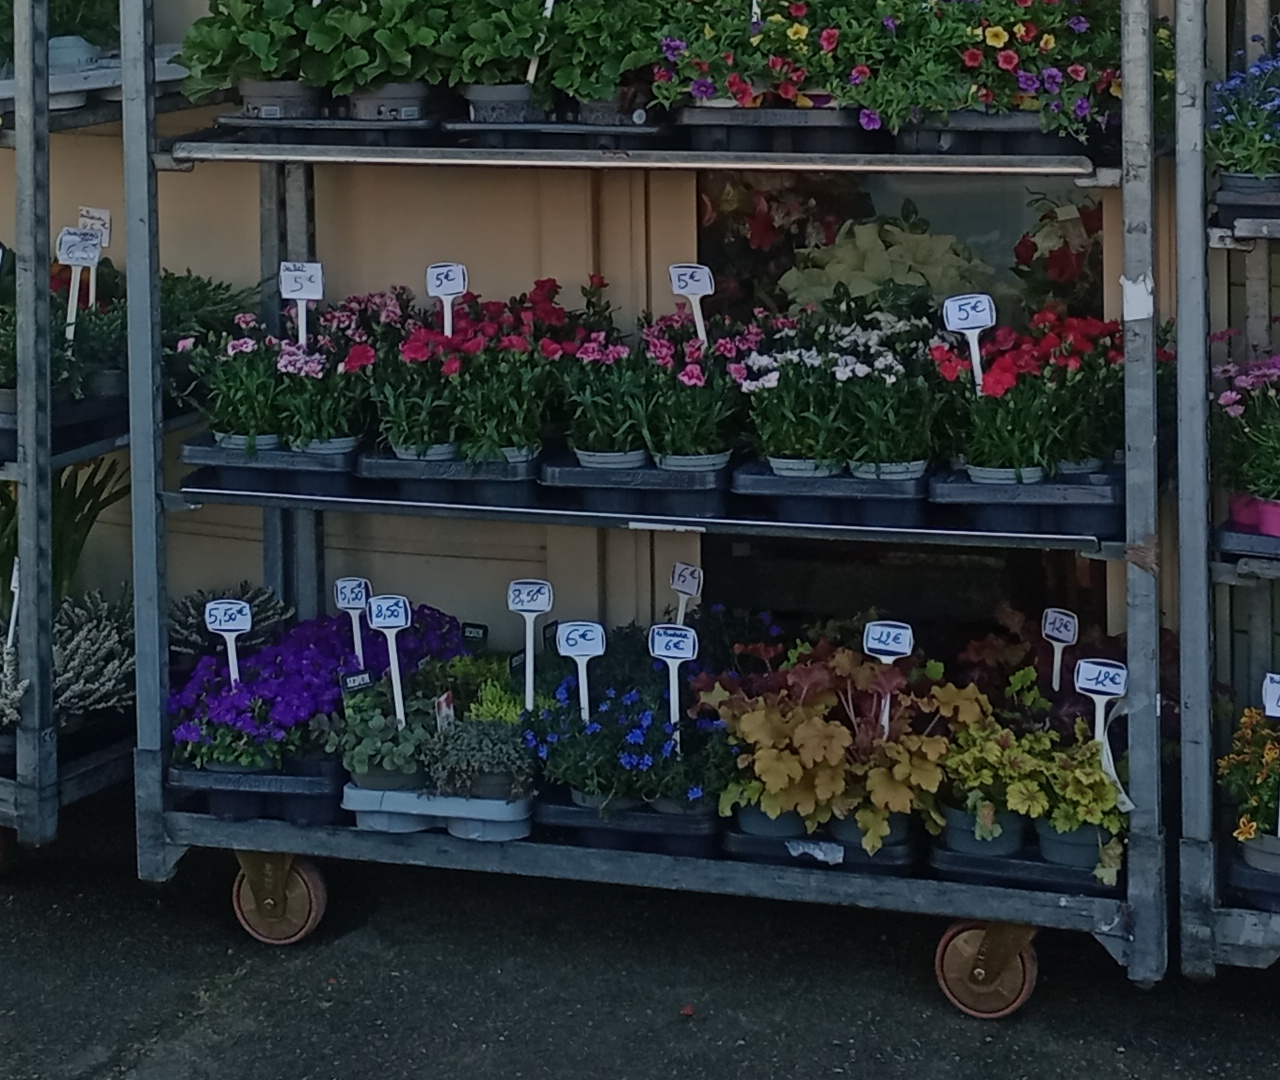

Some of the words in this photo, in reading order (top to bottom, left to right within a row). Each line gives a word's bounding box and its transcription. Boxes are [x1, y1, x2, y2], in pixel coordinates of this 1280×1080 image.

[435, 269, 455, 288] 5€
[677, 270, 701, 289] 5€
[958, 300, 986, 321] 5€
[512, 586, 546, 606] 8,50€
[208, 605, 248, 626] 5,50€
[375, 600, 403, 619] 8,50€
[1049, 620, 1072, 634] 12€
[565, 629, 595, 647] 6€
[664, 640, 685, 651] 6€
[871, 630, 903, 646] 12€
[1085, 670, 1122, 687] 12€
